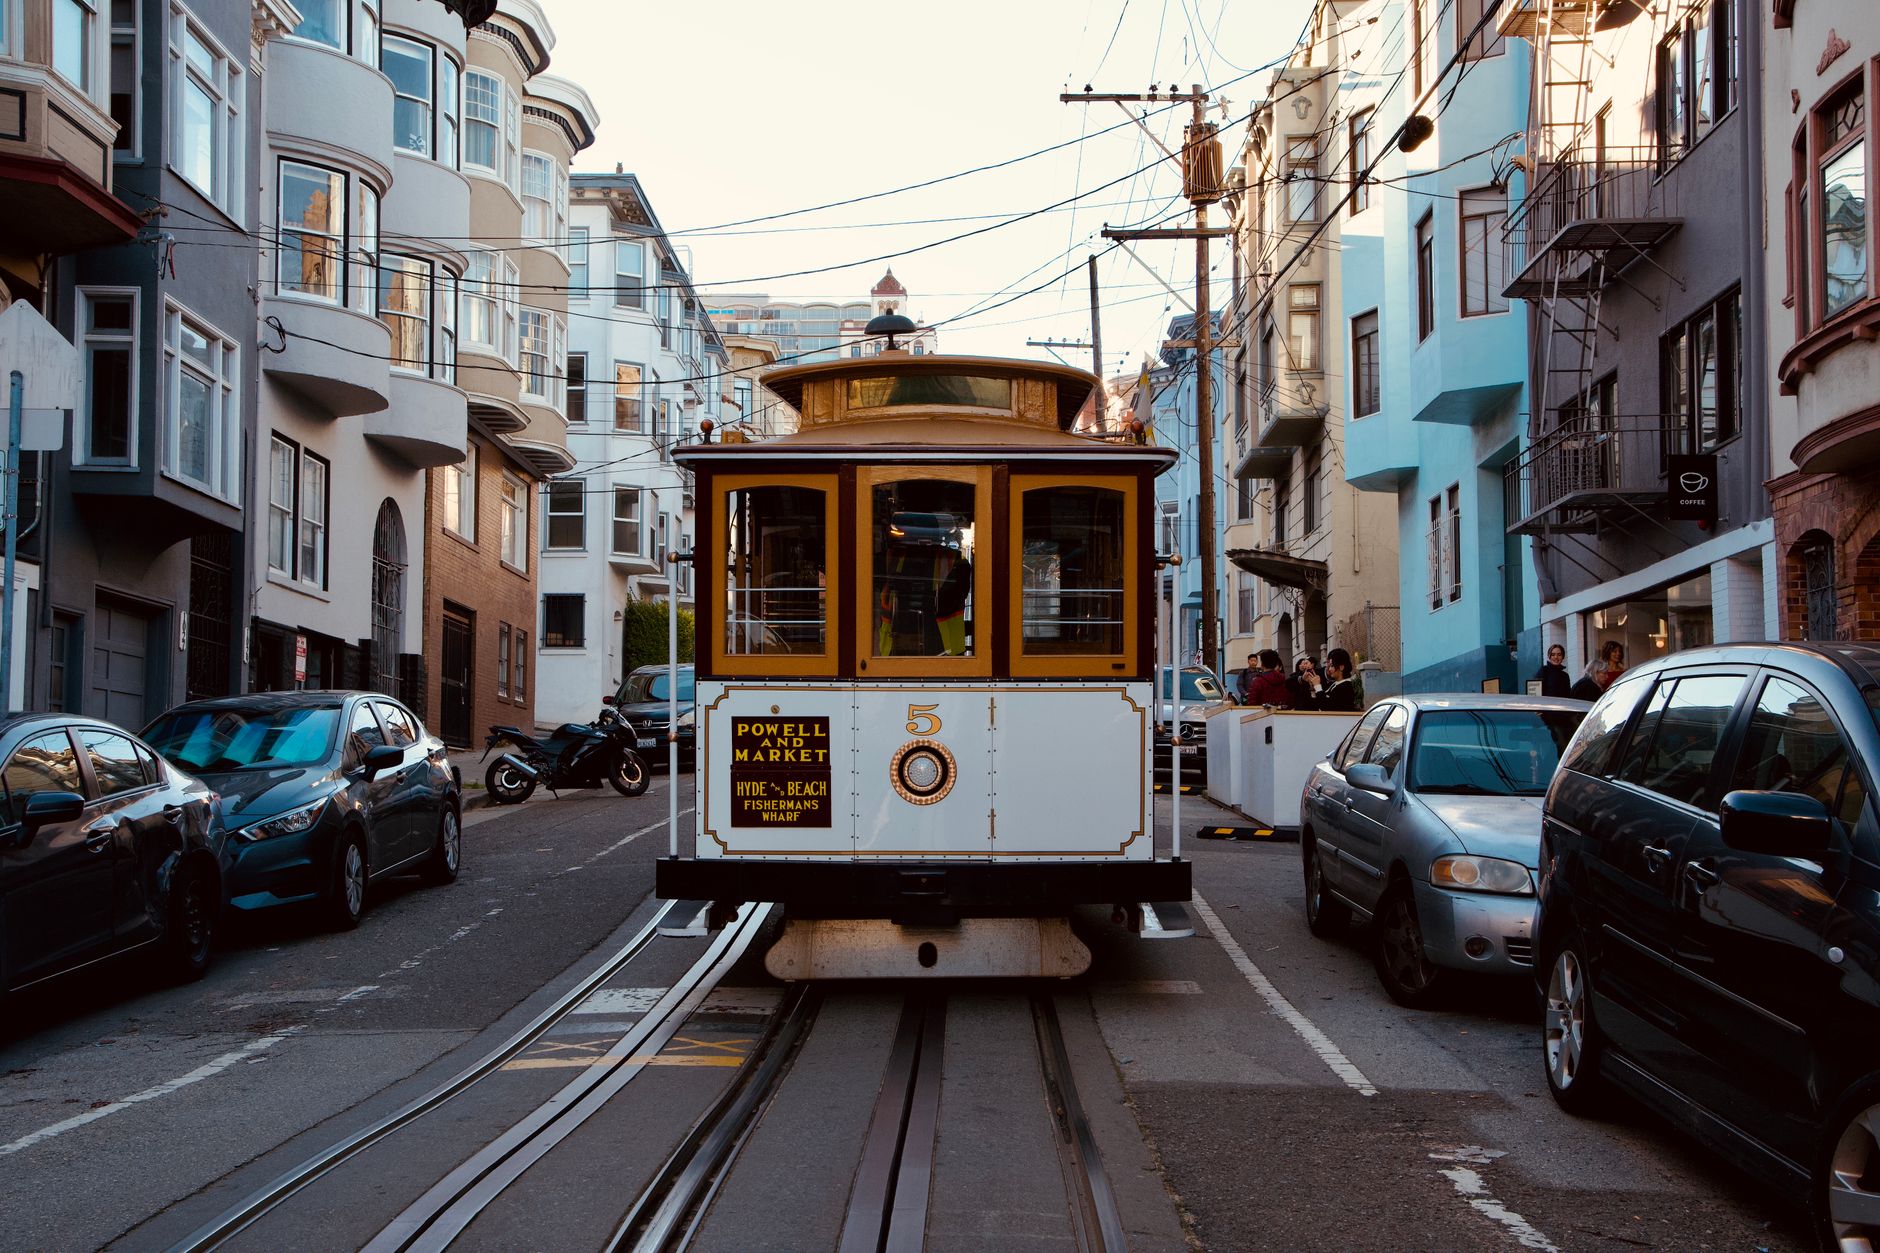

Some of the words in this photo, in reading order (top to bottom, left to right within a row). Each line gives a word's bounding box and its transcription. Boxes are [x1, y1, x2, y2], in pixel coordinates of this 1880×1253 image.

[906, 704, 942, 736] 5
[737, 723, 826, 736] POWELL
[760, 737, 804, 747] AND
[735, 749, 827, 761] MARKET
[736, 781, 767, 796] HYDE
[770, 782, 785, 796] AND
[787, 781, 827, 796] BEACH
[744, 800, 819, 810] FISHERMANS
[762, 812, 801, 821] WHARF
